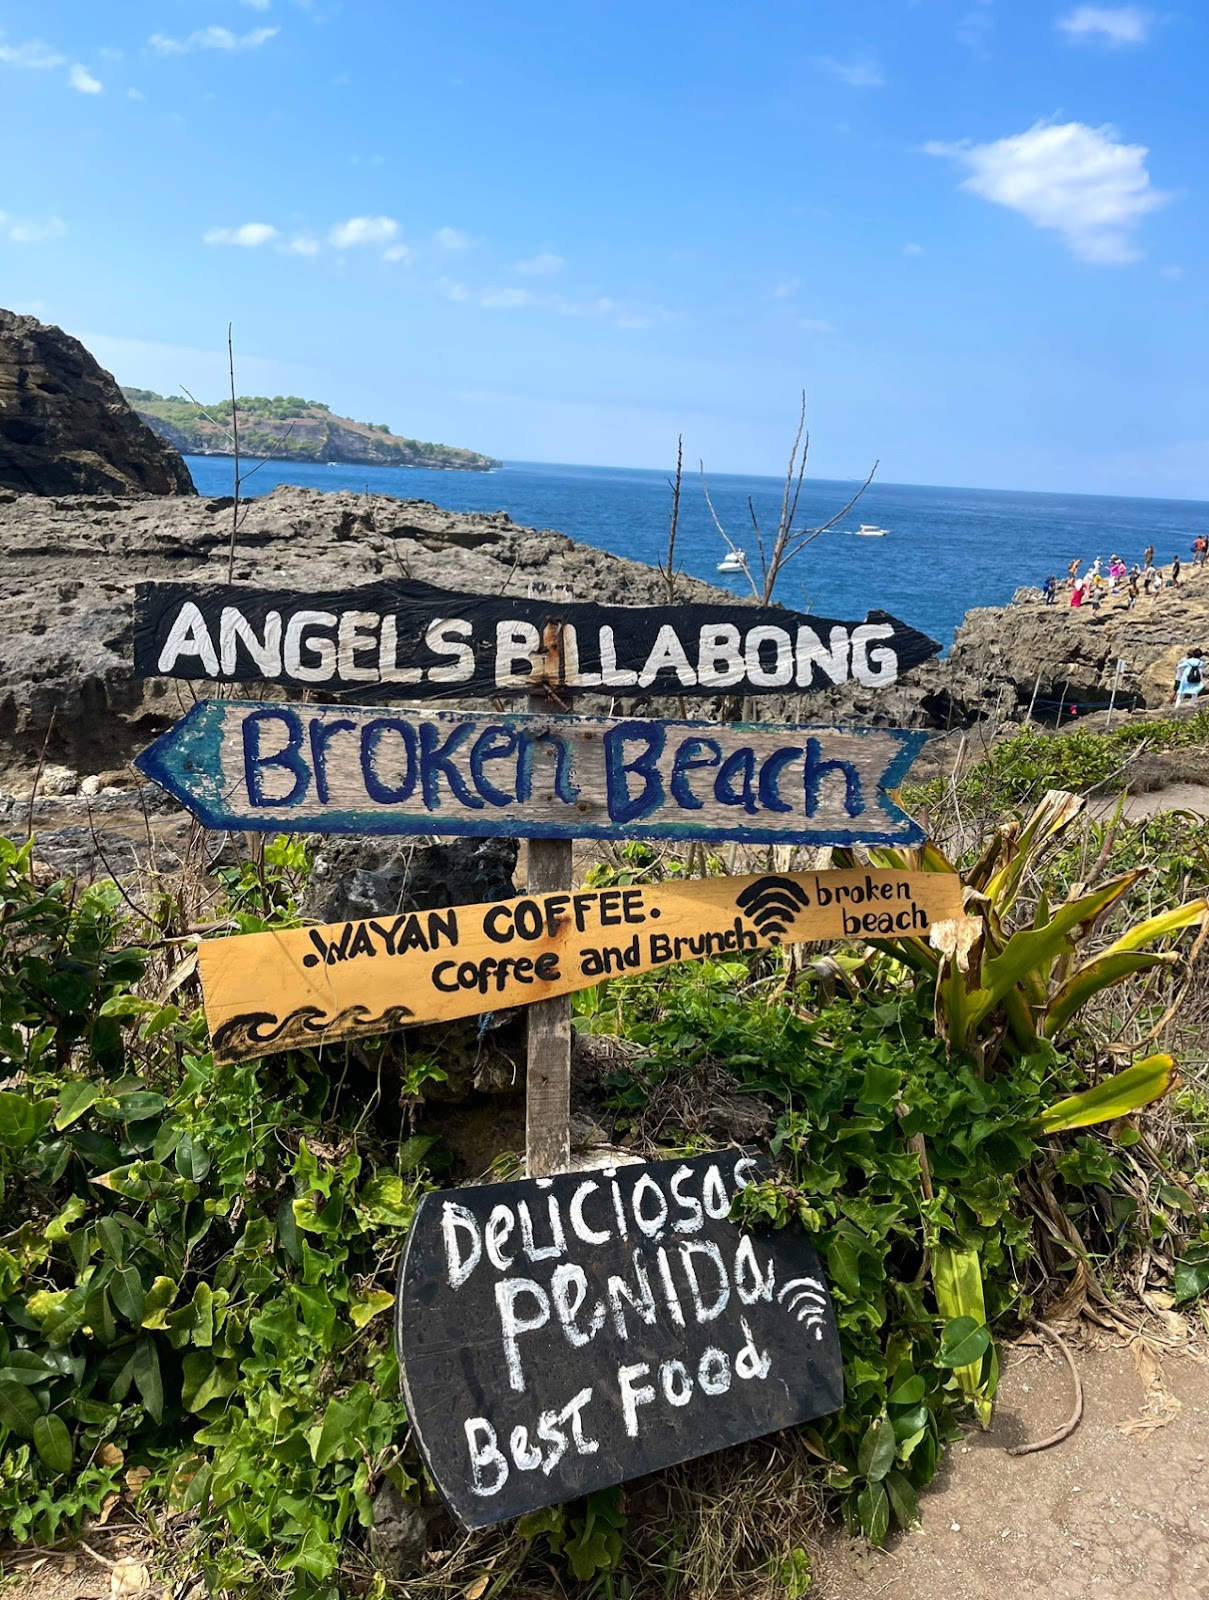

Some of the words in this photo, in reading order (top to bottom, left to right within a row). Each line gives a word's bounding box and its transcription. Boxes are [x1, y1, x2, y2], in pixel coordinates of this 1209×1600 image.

[157, 601, 476, 683] ANGELS
[495, 619, 899, 688] BILLABONG
[603, 720, 866, 824] Beach
[815, 876, 911, 906] broken
[843, 902, 929, 936] beach
[432, 952, 562, 994] Coffee
[580, 934, 640, 976] and
[650, 917, 757, 964] Brunch
[617, 1314, 772, 1438] Food
